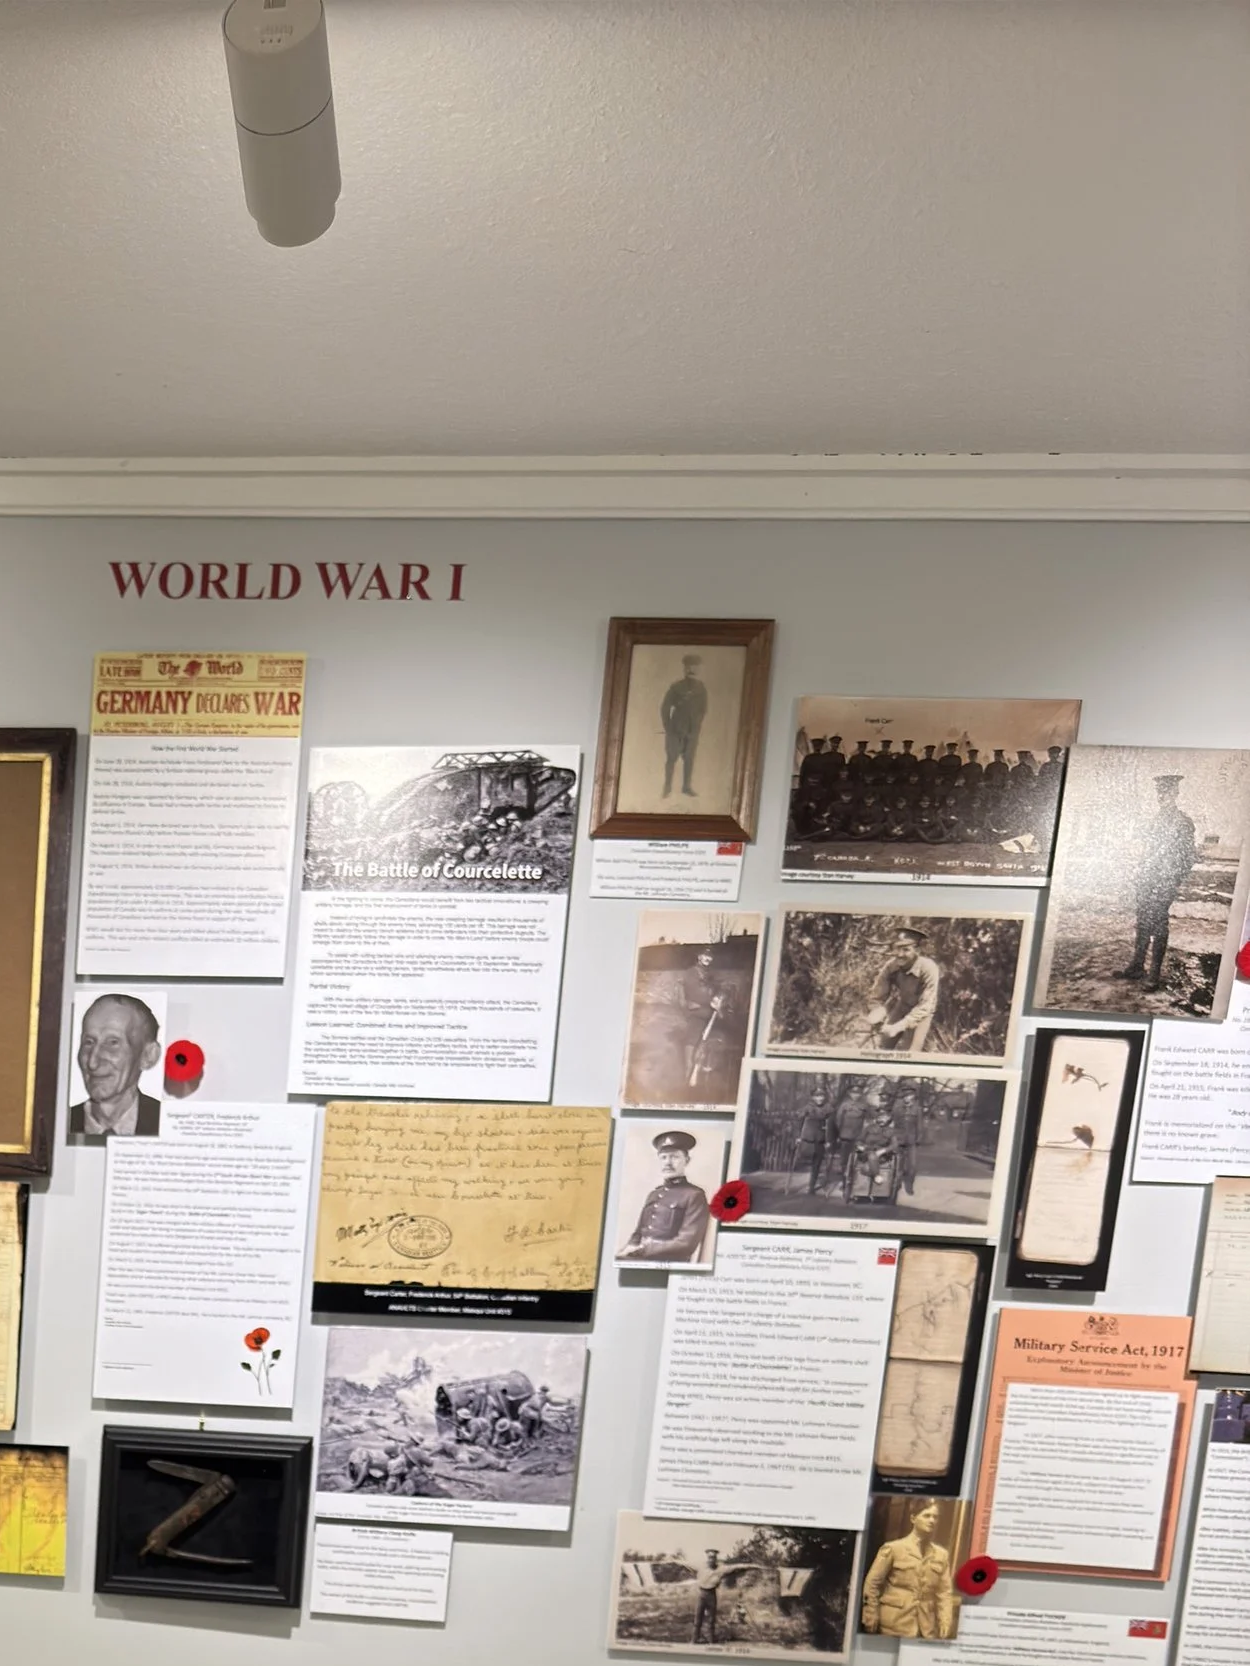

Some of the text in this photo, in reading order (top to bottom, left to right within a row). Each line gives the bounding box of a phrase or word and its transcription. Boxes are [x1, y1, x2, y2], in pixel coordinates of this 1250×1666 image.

[108, 562, 468, 601] WORLD WAR I
[96, 691, 301, 716] GERMANY DECLARES WAR
[333, 861, 542, 881] The Battle of Courcelette
[1014, 1337, 1185, 1358] Military Service Act, 1917
